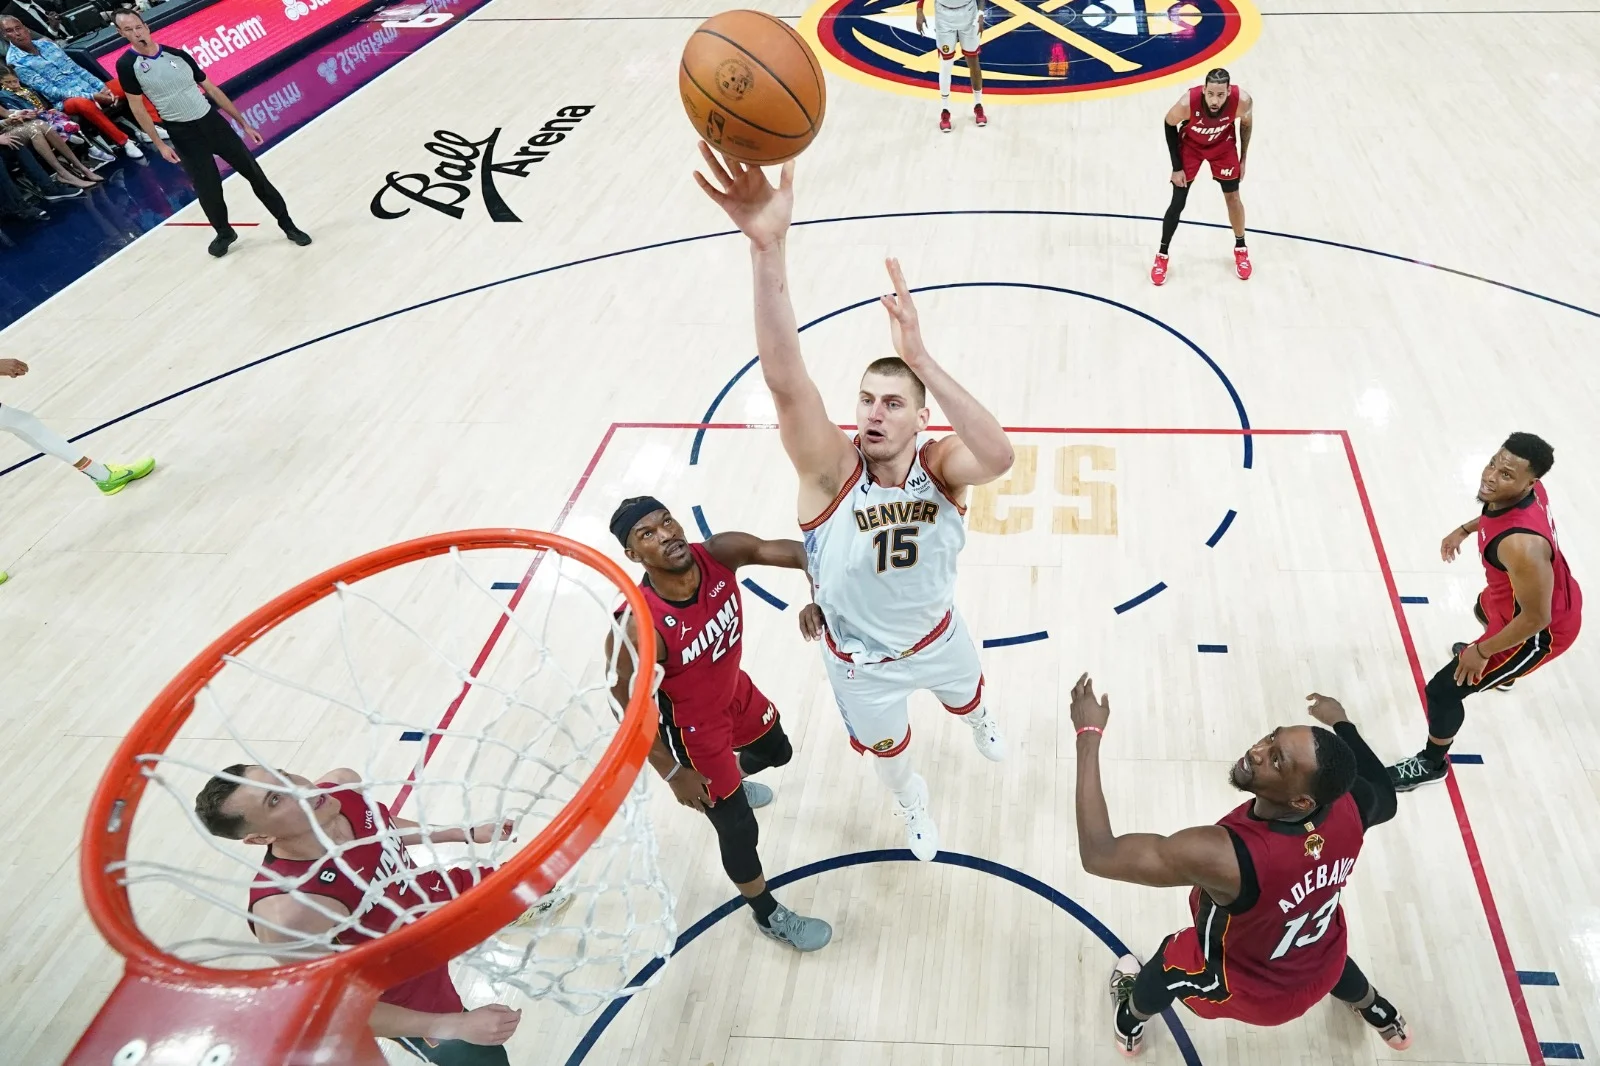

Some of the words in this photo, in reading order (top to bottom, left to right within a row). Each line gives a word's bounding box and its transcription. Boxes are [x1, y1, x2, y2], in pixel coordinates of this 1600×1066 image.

[370, 127, 523, 222] Ball
[491, 104, 596, 178] Arena
[907, 472, 927, 488] WU
[855, 500, 939, 532] DENVER
[873, 526, 919, 573] 15
[709, 580, 726, 598] UKG
[664, 615, 677, 627] 6
[681, 593, 739, 665] MIAMI
[711, 616, 741, 662] 22
[364, 810, 373, 829] UKG
[319, 870, 337, 883] 6
[1278, 857, 1355, 914] ADEBAYO
[1269, 891, 1340, 960] 13
